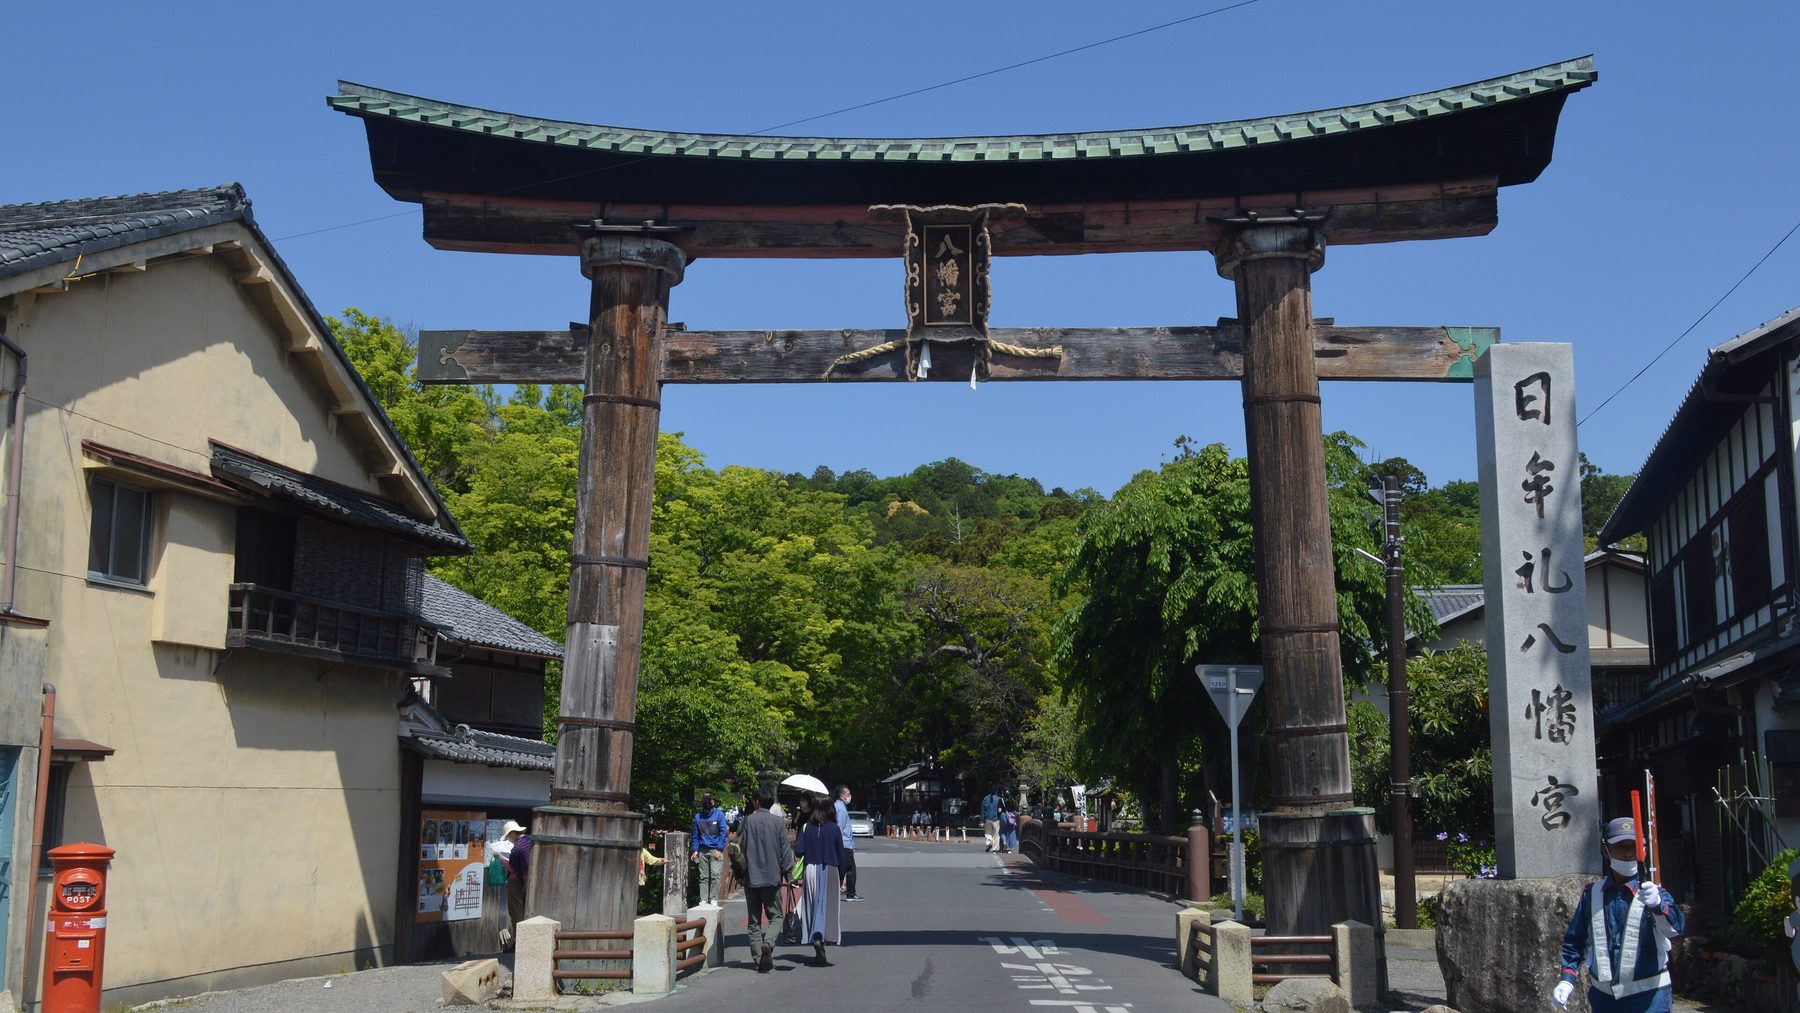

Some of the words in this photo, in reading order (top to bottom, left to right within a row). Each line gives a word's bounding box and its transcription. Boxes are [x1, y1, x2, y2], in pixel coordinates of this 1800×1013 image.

[934, 233, 964, 317] 八幡宮
[1514, 371, 1580, 832] 日牟礼八幡宮
